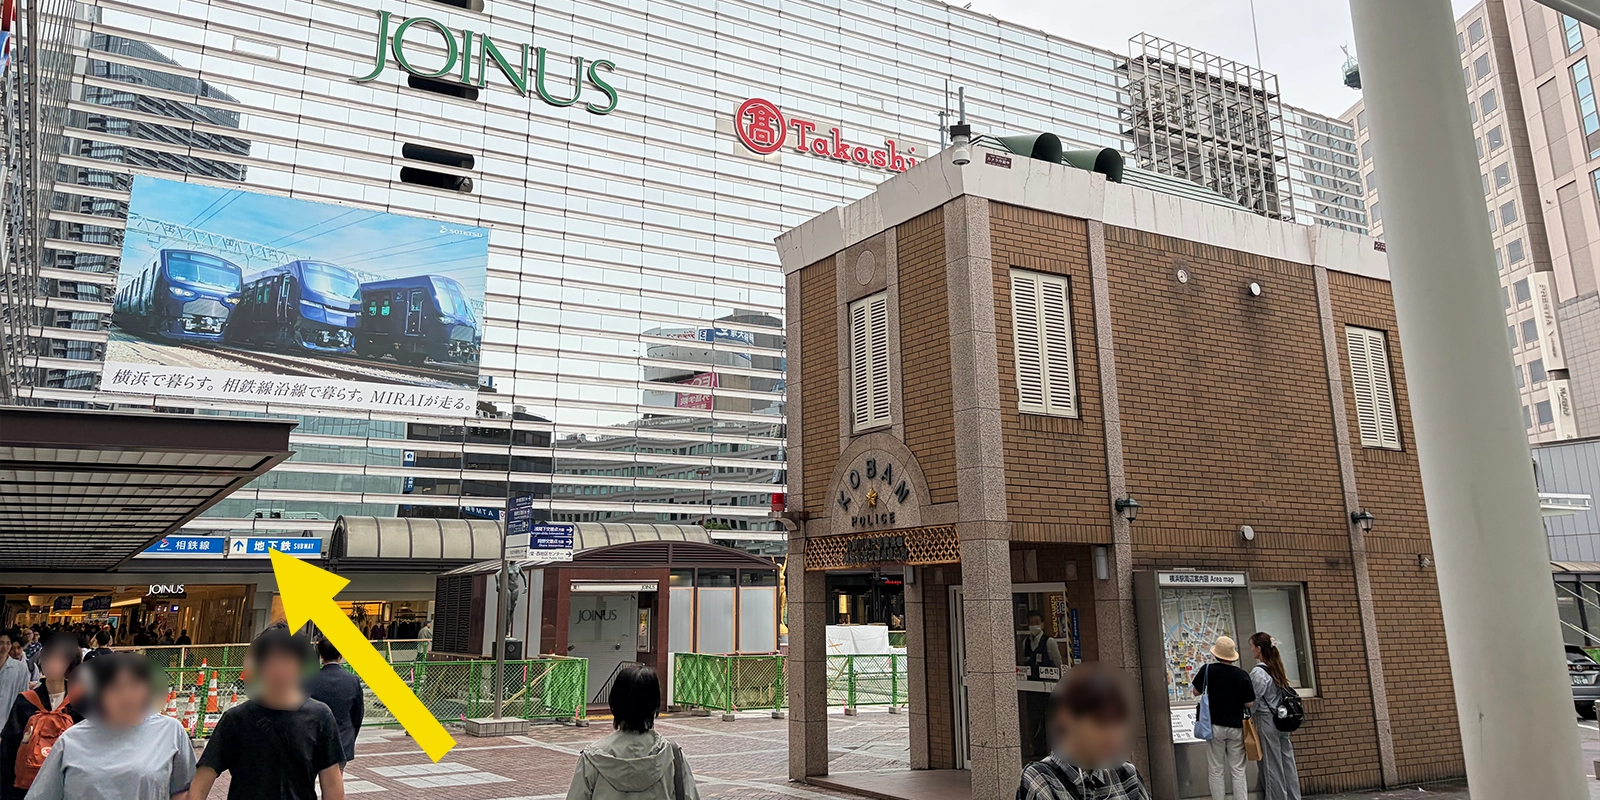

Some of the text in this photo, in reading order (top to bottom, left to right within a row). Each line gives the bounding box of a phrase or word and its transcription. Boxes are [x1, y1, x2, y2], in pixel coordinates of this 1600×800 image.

[348, 9, 619, 115] JOINUS
[789, 118, 917, 173] Takashi
[449, 229, 482, 237] SOTETSU
[837, 458, 910, 511] KOBAN
[851, 512, 896, 528] POLICE
[175, 540, 211, 551] 相鉄線
[253, 540, 315, 552] 地下鉄 SUBWAY
[146, 584, 185, 597] JOINUS
[575, 609, 618, 625] JOINUS
